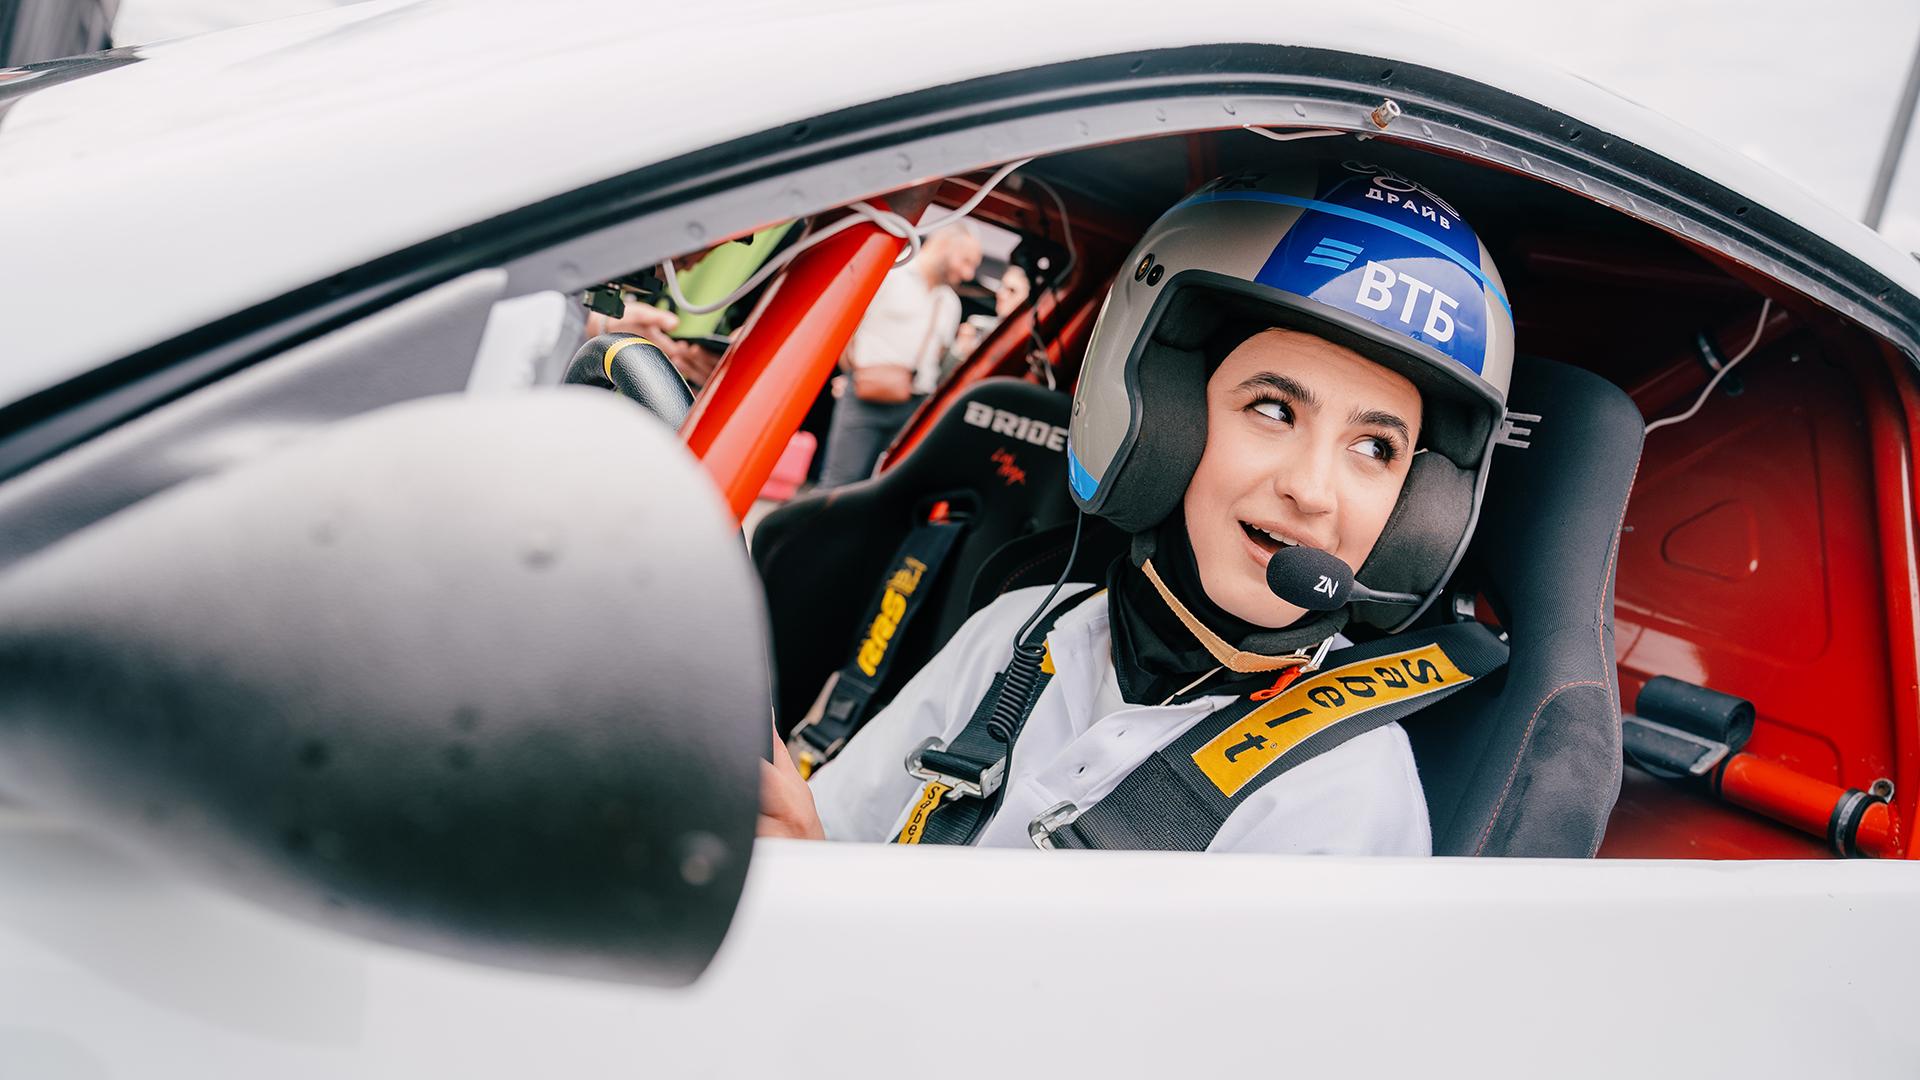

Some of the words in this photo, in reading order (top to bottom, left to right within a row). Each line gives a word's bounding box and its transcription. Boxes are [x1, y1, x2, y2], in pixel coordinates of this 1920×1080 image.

[1365, 187, 1451, 230] ДРАЙВ
[1355, 260, 1460, 343] ВТБ
[964, 400, 1069, 452] BRIDE
[1224, 657, 1444, 764] Sabelt
